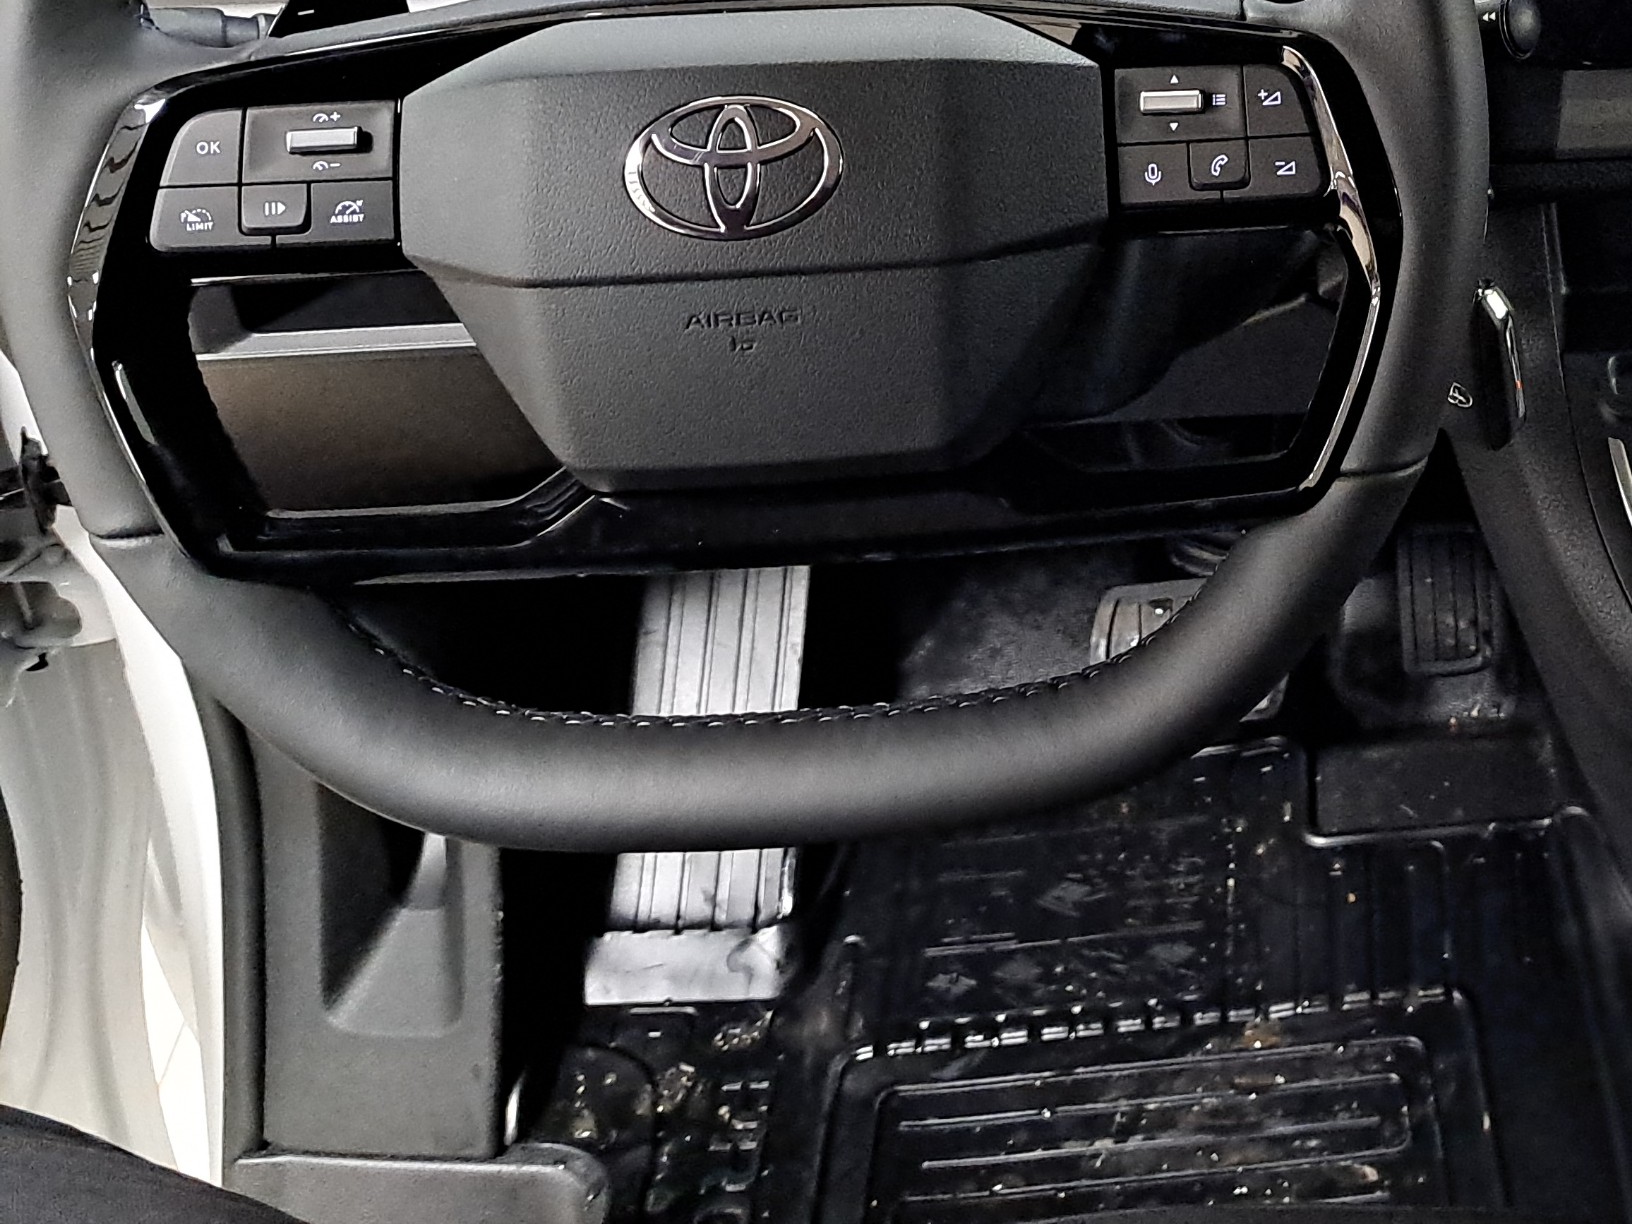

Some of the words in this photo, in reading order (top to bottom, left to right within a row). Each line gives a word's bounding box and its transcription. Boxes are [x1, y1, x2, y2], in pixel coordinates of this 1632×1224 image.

[196, 141, 221, 155] OK
[329, 214, 365, 223] ASSIST
[186, 222, 214, 232] LIMIT
[684, 309, 801, 329] AIRBAG
